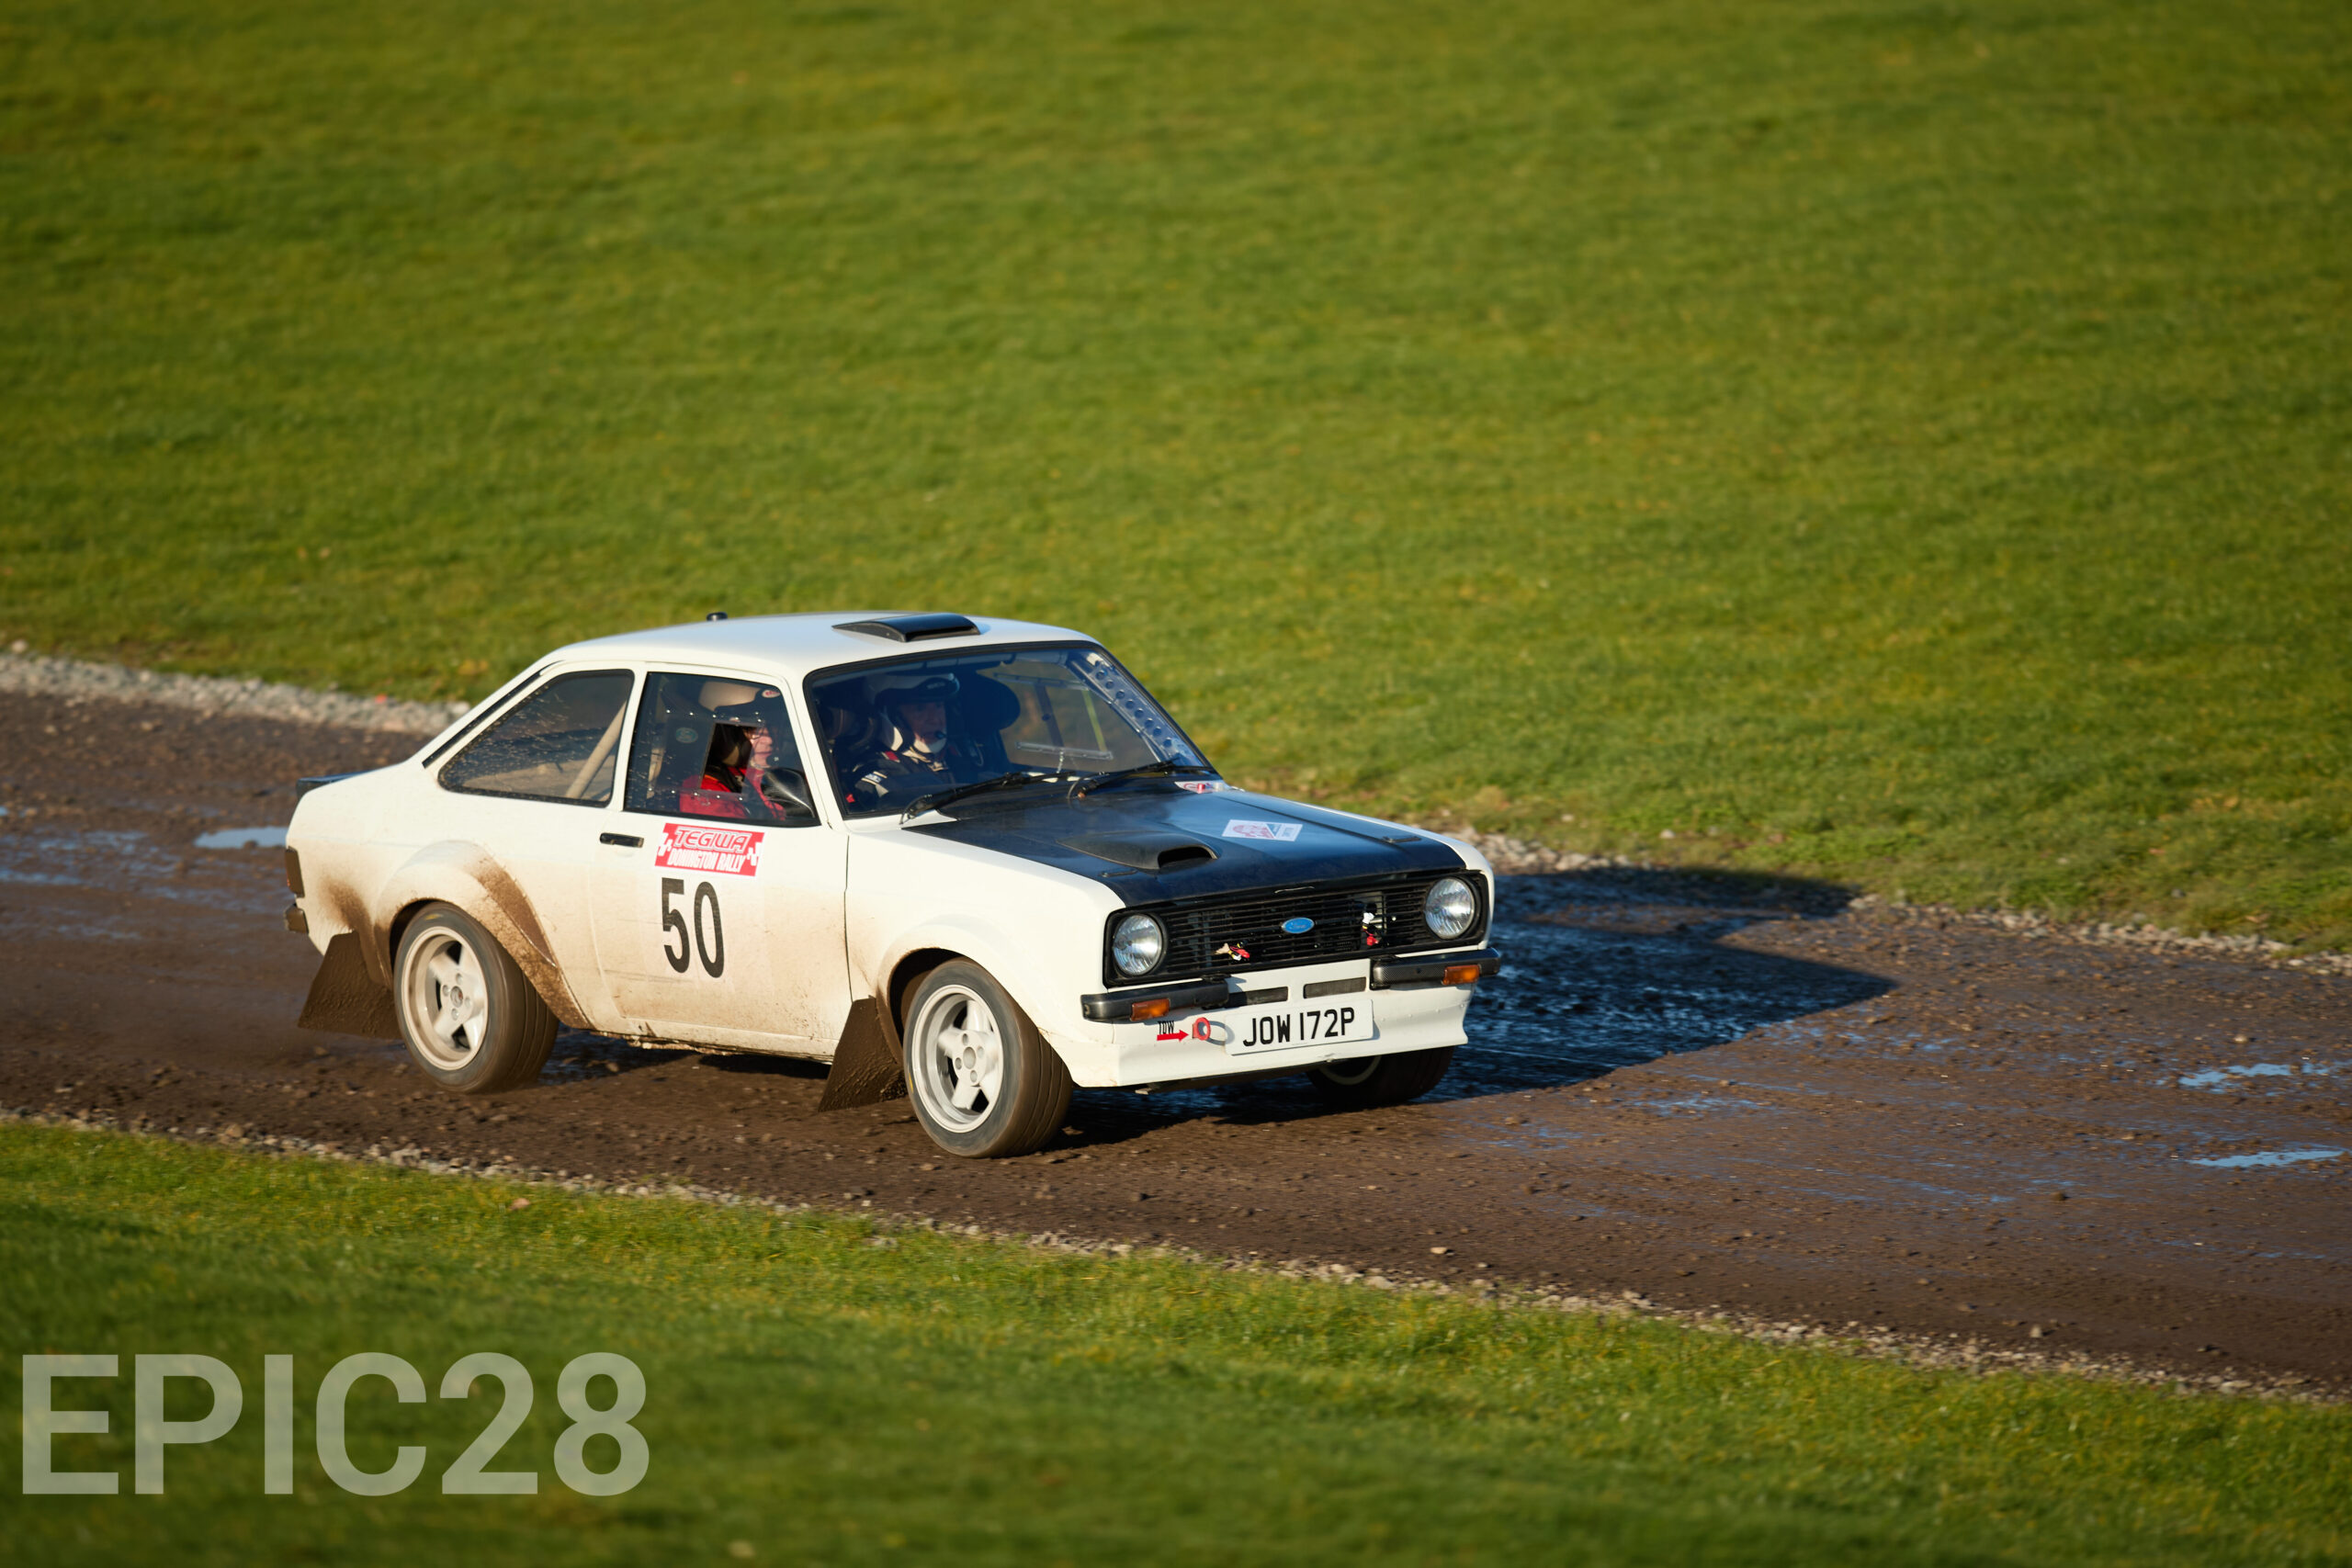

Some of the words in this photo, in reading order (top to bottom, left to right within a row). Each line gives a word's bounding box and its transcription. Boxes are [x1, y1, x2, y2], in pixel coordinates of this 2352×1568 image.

[675, 827, 752, 852] TEGIWA
[667, 848, 718, 870] DONINGTON
[717, 852, 746, 873] RALLY
[662, 877, 724, 978] 50
[1158, 1021, 1174, 1034] TOW
[1243, 1014, 1290, 1046] JOW
[1300, 1007, 1355, 1040] 172P
